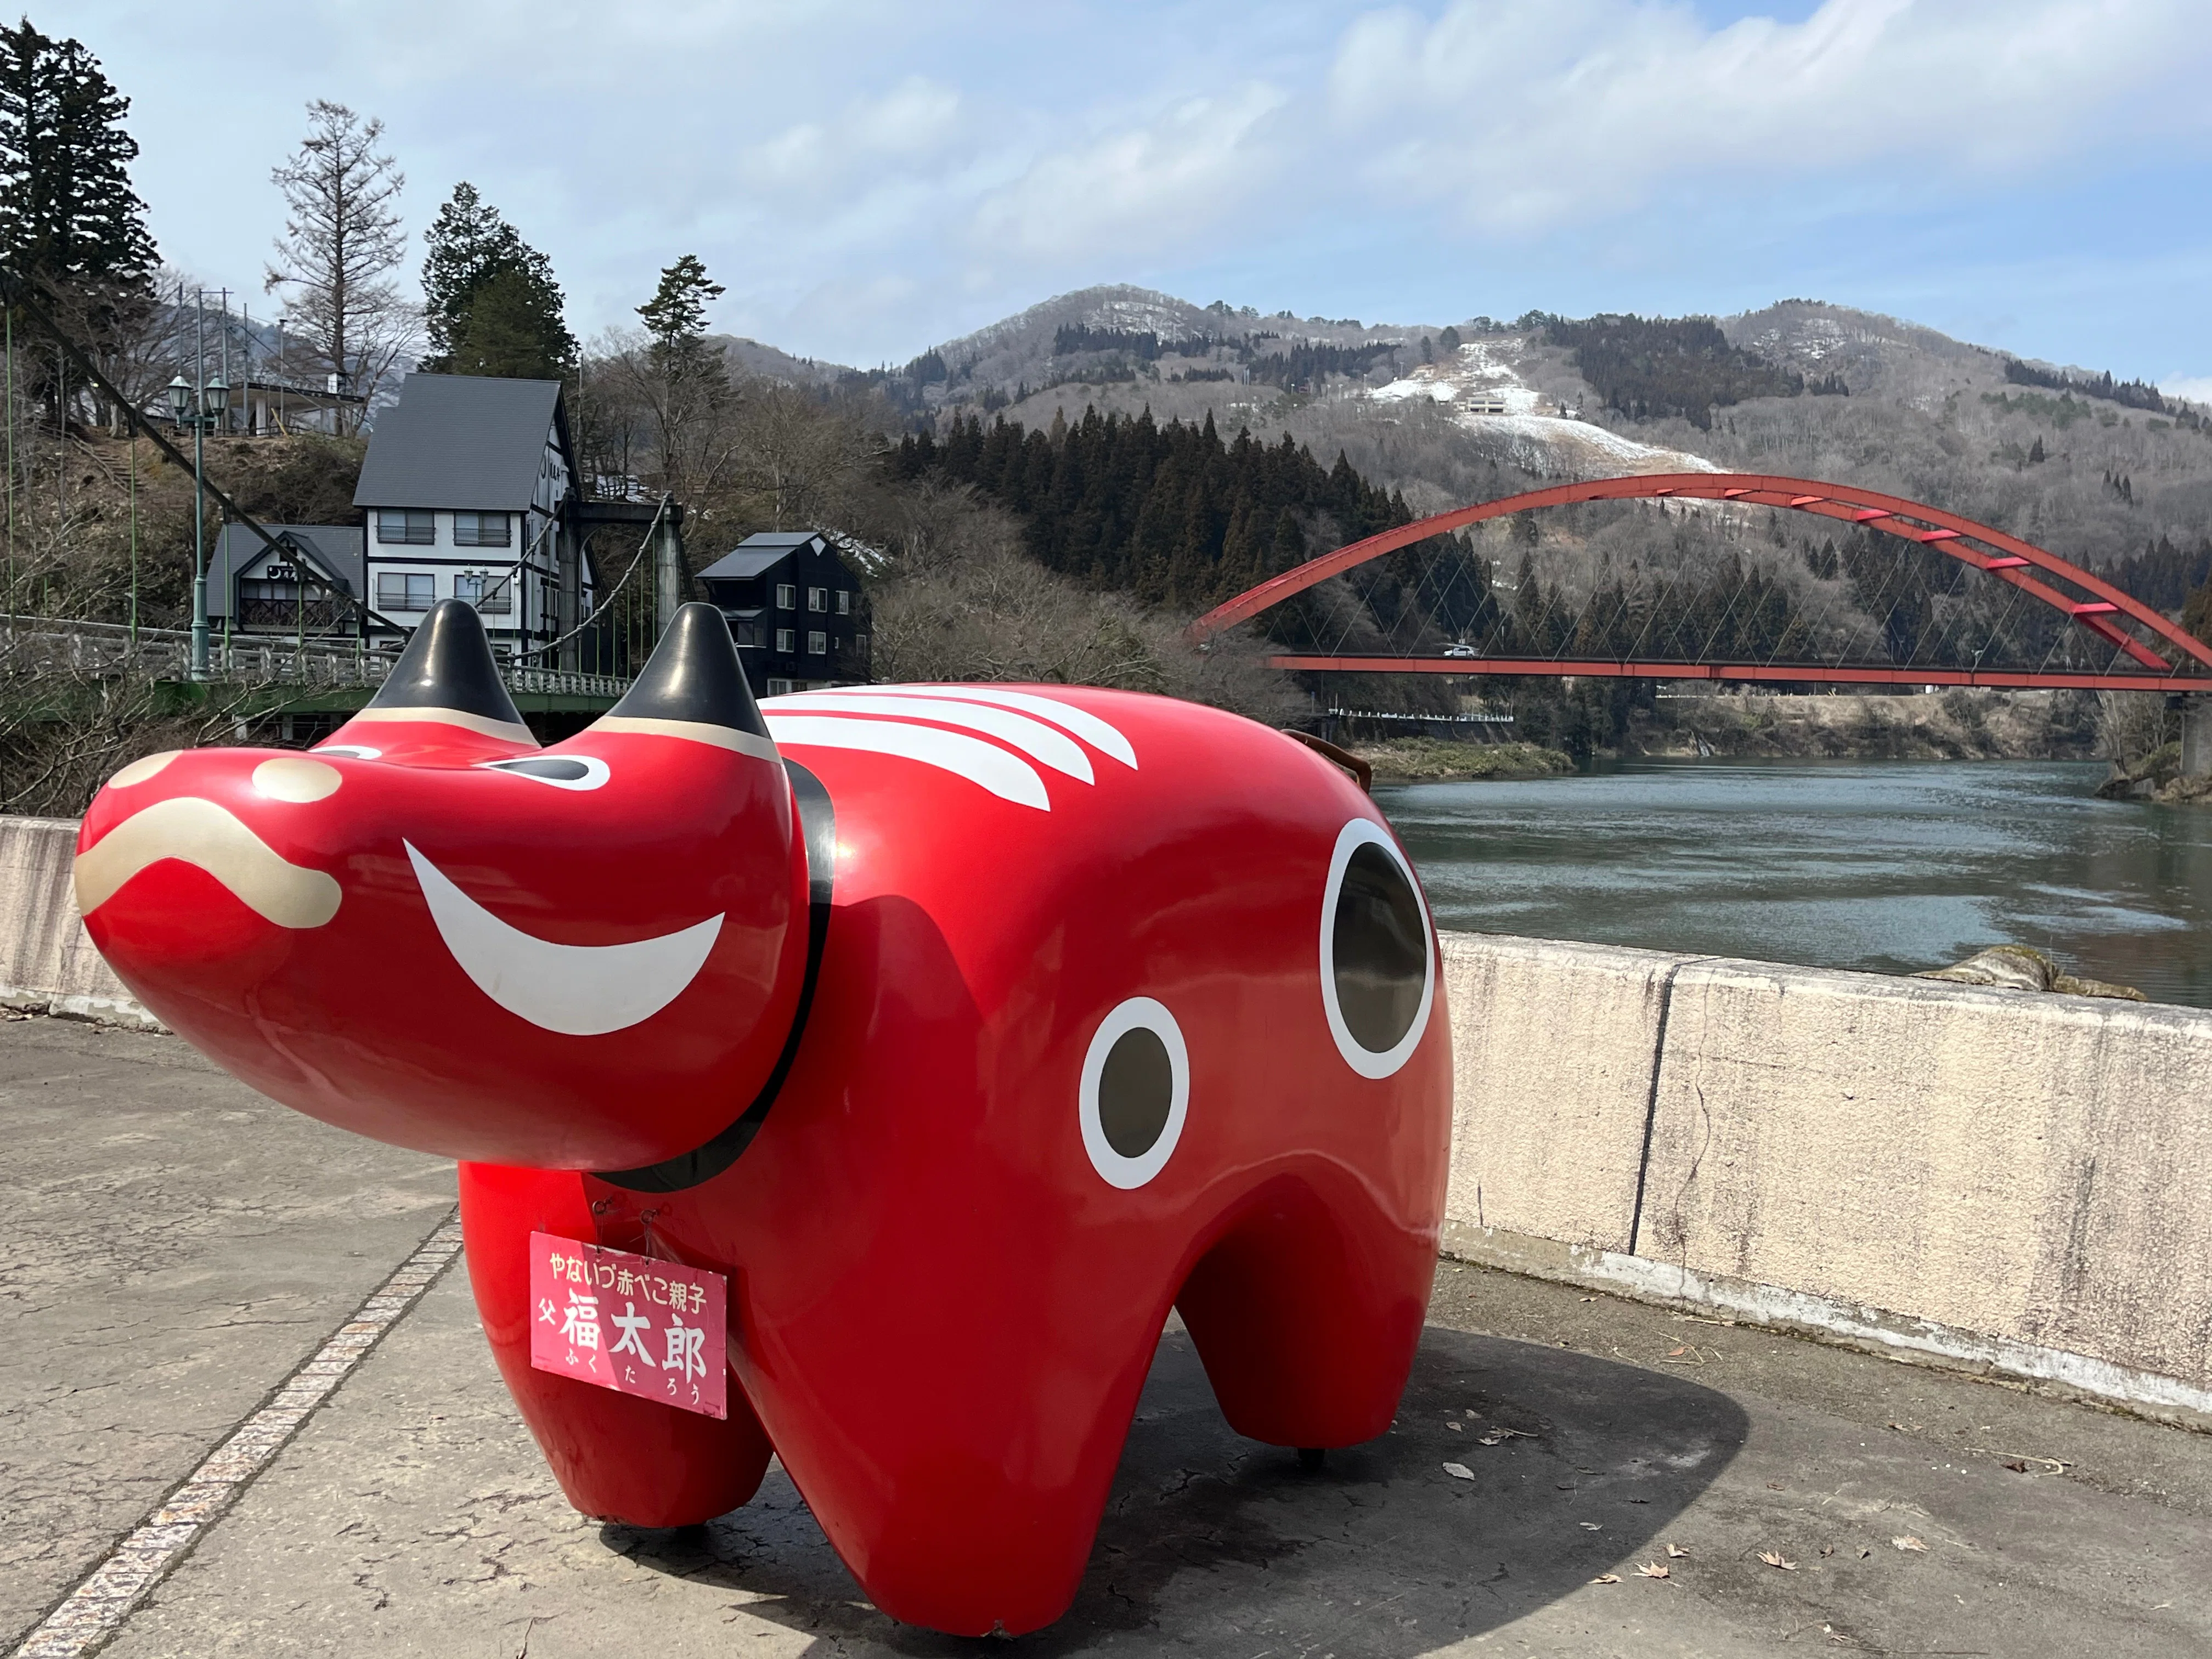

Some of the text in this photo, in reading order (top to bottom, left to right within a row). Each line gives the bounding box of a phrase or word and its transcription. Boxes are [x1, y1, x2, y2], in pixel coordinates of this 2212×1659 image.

[550, 1252, 707, 1314] やないづ赤べこ親子
[538, 1287, 707, 1384] 父 福太郎
